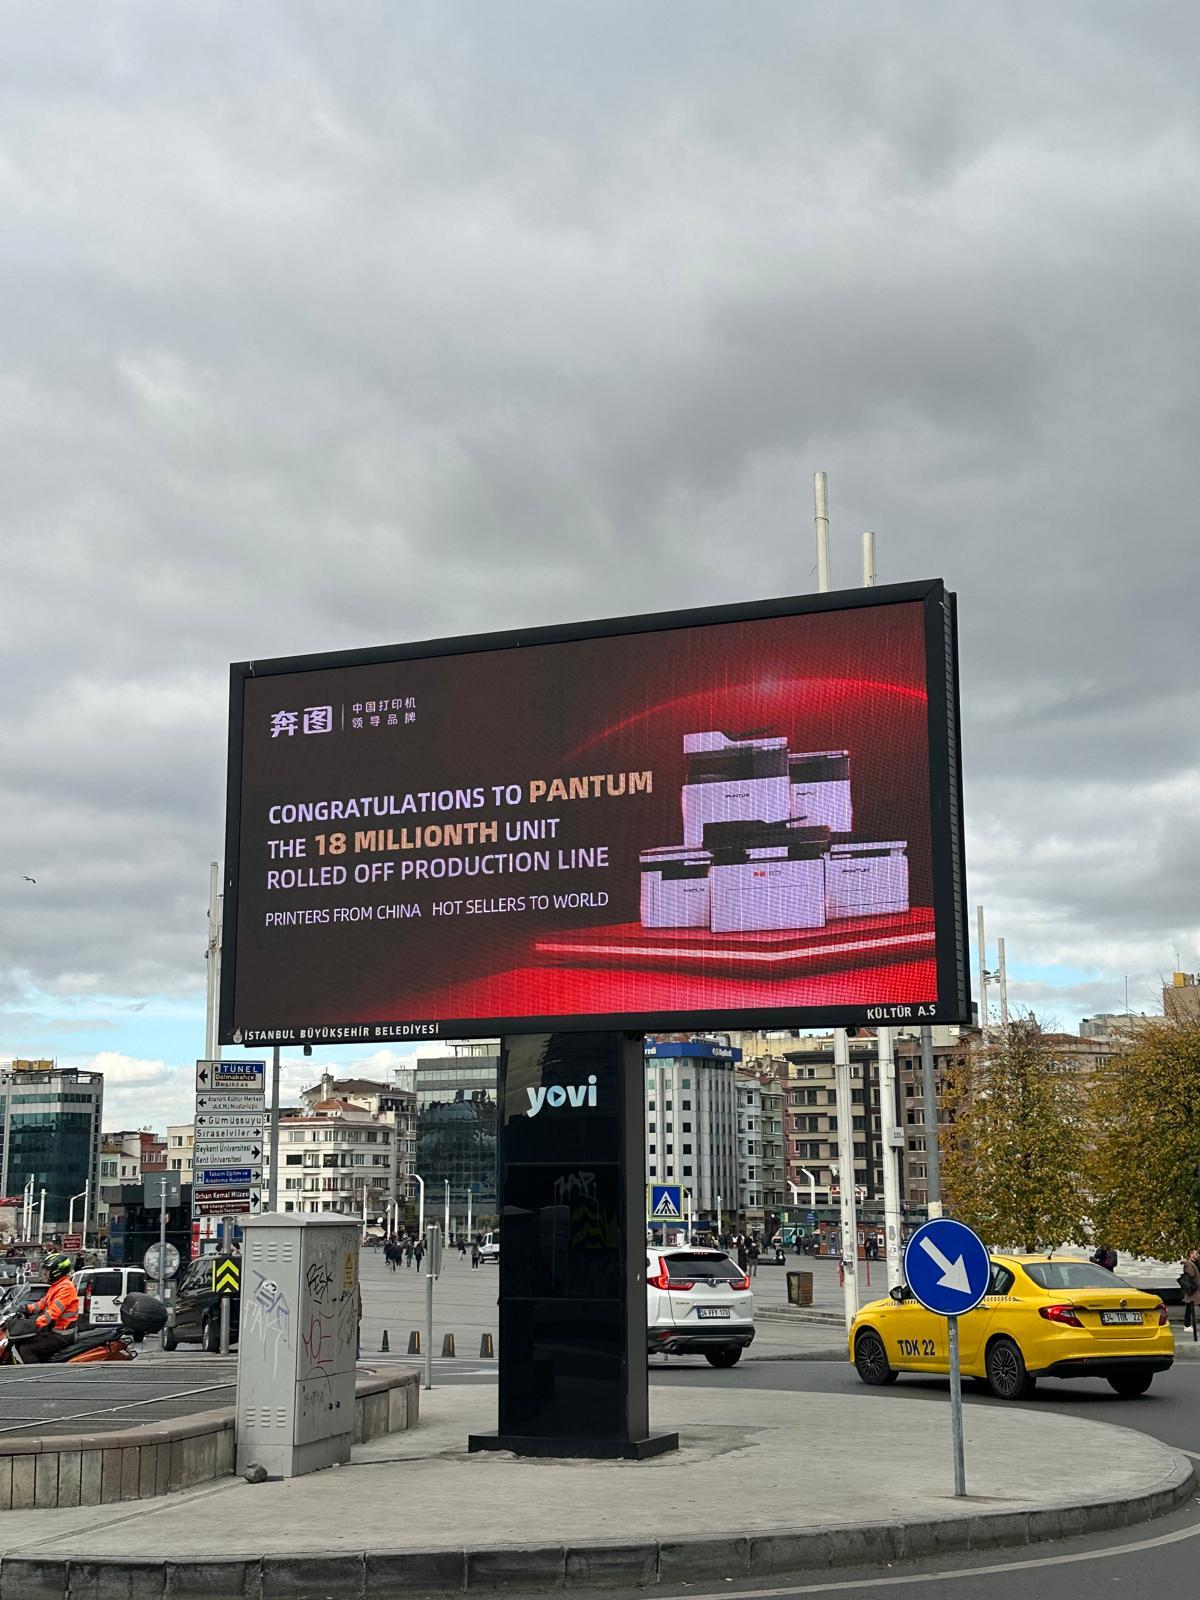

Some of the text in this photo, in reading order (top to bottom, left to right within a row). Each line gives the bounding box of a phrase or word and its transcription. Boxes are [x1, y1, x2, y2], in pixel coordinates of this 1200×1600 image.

[352, 697, 416, 714] 中国打印机
[270, 705, 333, 738] 奔图
[352, 711, 416, 729] 领导品牌
[268, 771, 653, 825] CONGRATULATIONS TO PANTUM
[267, 818, 560, 860] THE 18 MILLIONTH UNIT
[267, 847, 609, 890] ROLLED OFF PRODUCTION LINE
[265, 891, 609, 927] PRINTERS FROM CHINA HOT SELLERS TO WORLD
[867, 1005, 912, 1020] KÜLTÜR
[244, 1022, 439, 1041] İSTANBUL BÜYÜKŞEHİR BELEDİYESİ
[222, 1064, 259, 1073] TÜNEL
[526, 1074, 597, 1118] yovi
[208, 1116, 262, 1126] Gümüşsuyu
[197, 1127, 250, 1138] Sıraselviler
[196, 1142, 251, 1154] Beykent Üniversitesi
[196, 1154, 242, 1164] Kent Üniversitesi
[213, 1191, 230, 1199] Kemal
[1104, 1313, 1113, 1321] 34
[1133, 1312, 1141, 1321] 22
[897, 1339, 936, 1356] TDK 22
